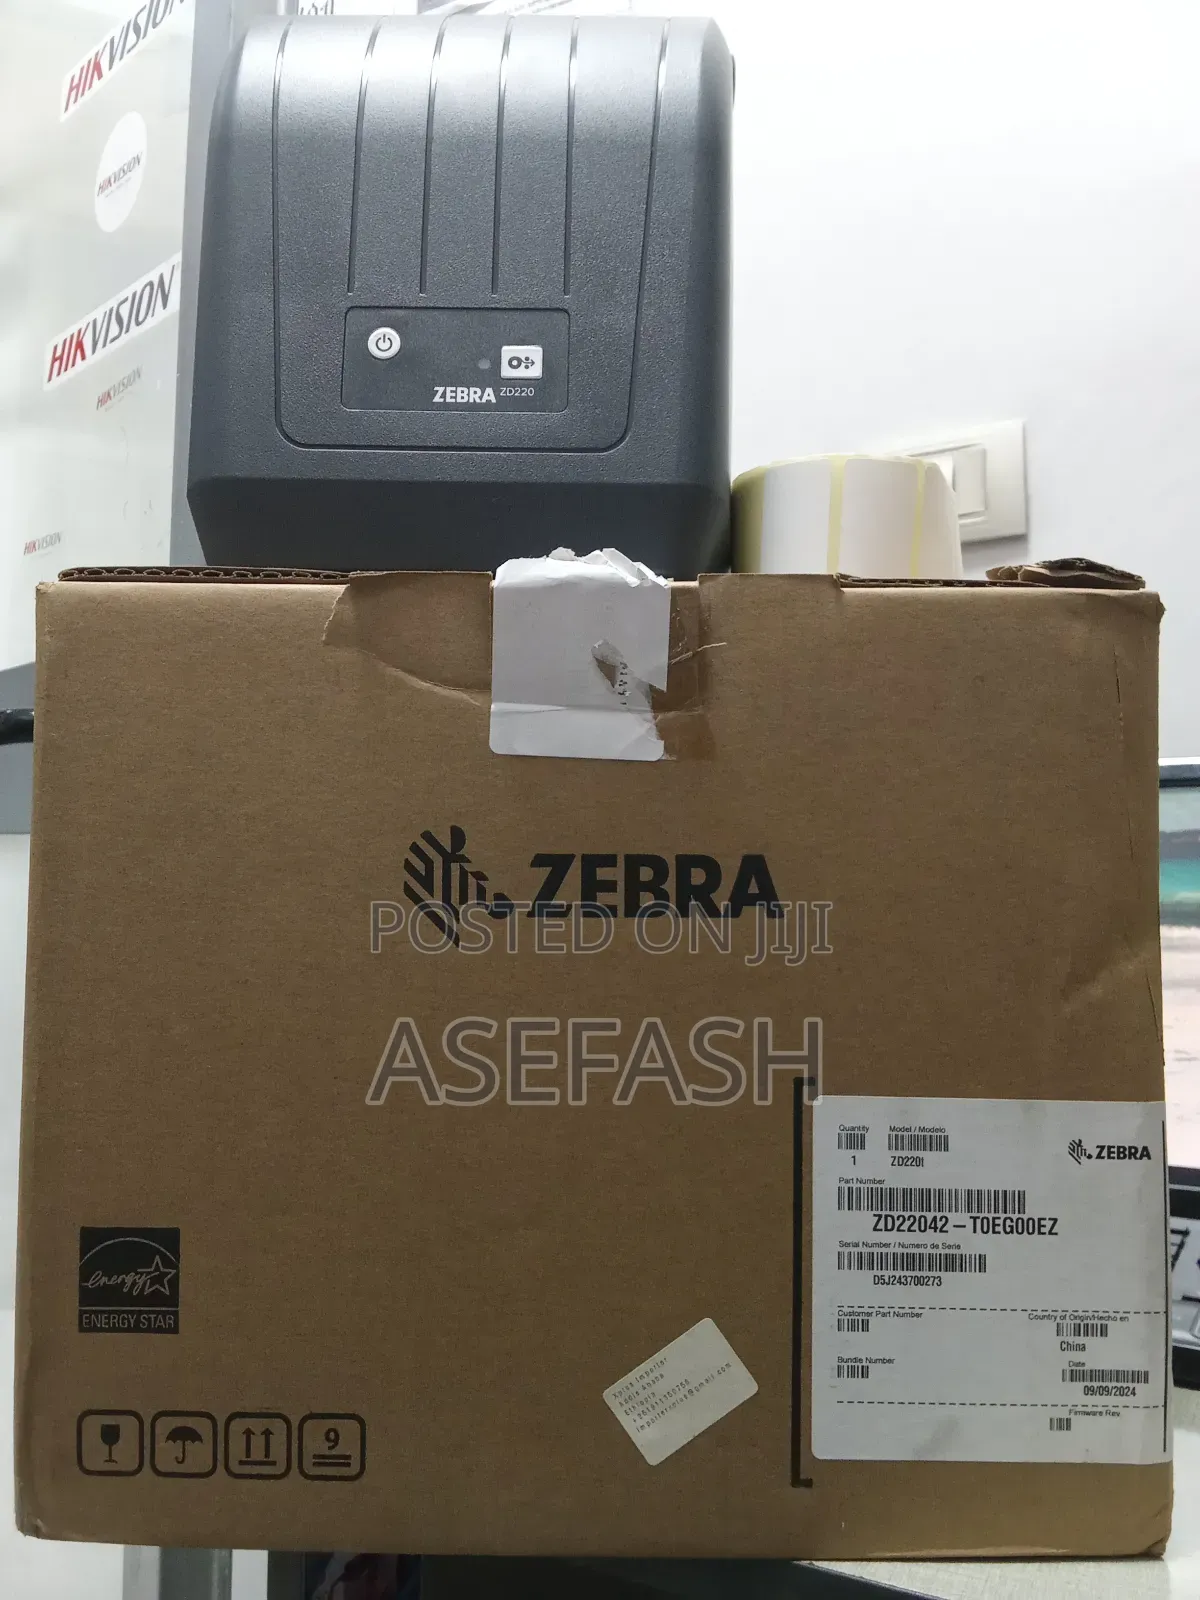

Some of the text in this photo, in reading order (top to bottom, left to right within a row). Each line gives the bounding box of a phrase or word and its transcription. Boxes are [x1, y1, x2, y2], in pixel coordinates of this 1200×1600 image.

[97, 151, 143, 197] HIKVISION
[47, 264, 176, 383] HIKVISION
[96, 364, 143, 411] HIKVISION
[432, 387, 535, 403] ZEBRA ZD220
[526, 853, 785, 919] ZEBRA
[838, 1124, 870, 1134] Quantity
[889, 1125, 912, 1133] Model
[918, 1125, 946, 1134] Modelo
[1095, 1144, 1152, 1161] ZEBRA
[851, 1155, 857, 1166] 1
[890, 1155, 925, 1168] ZD220t
[838, 1177, 885, 1185] Part Number
[838, 1240, 860, 1248] Serial
[862, 1241, 892, 1249] Number
[941, 1242, 961, 1250] Serie
[873, 1275, 942, 1287] D5J243700273
[837, 1309, 923, 1319] Customer Part Number
[1028, 1313, 1057, 1322] Country
[82, 1314, 174, 1328] ENERGY STAR
[1060, 1341, 1086, 1352] China
[837, 1356, 895, 1365] Bundle Number
[1068, 1360, 1086, 1368] Date
[1083, 1385, 1137, 1397] 09/09/2024
[1068, 1408, 1121, 1417] Firmware Rev
